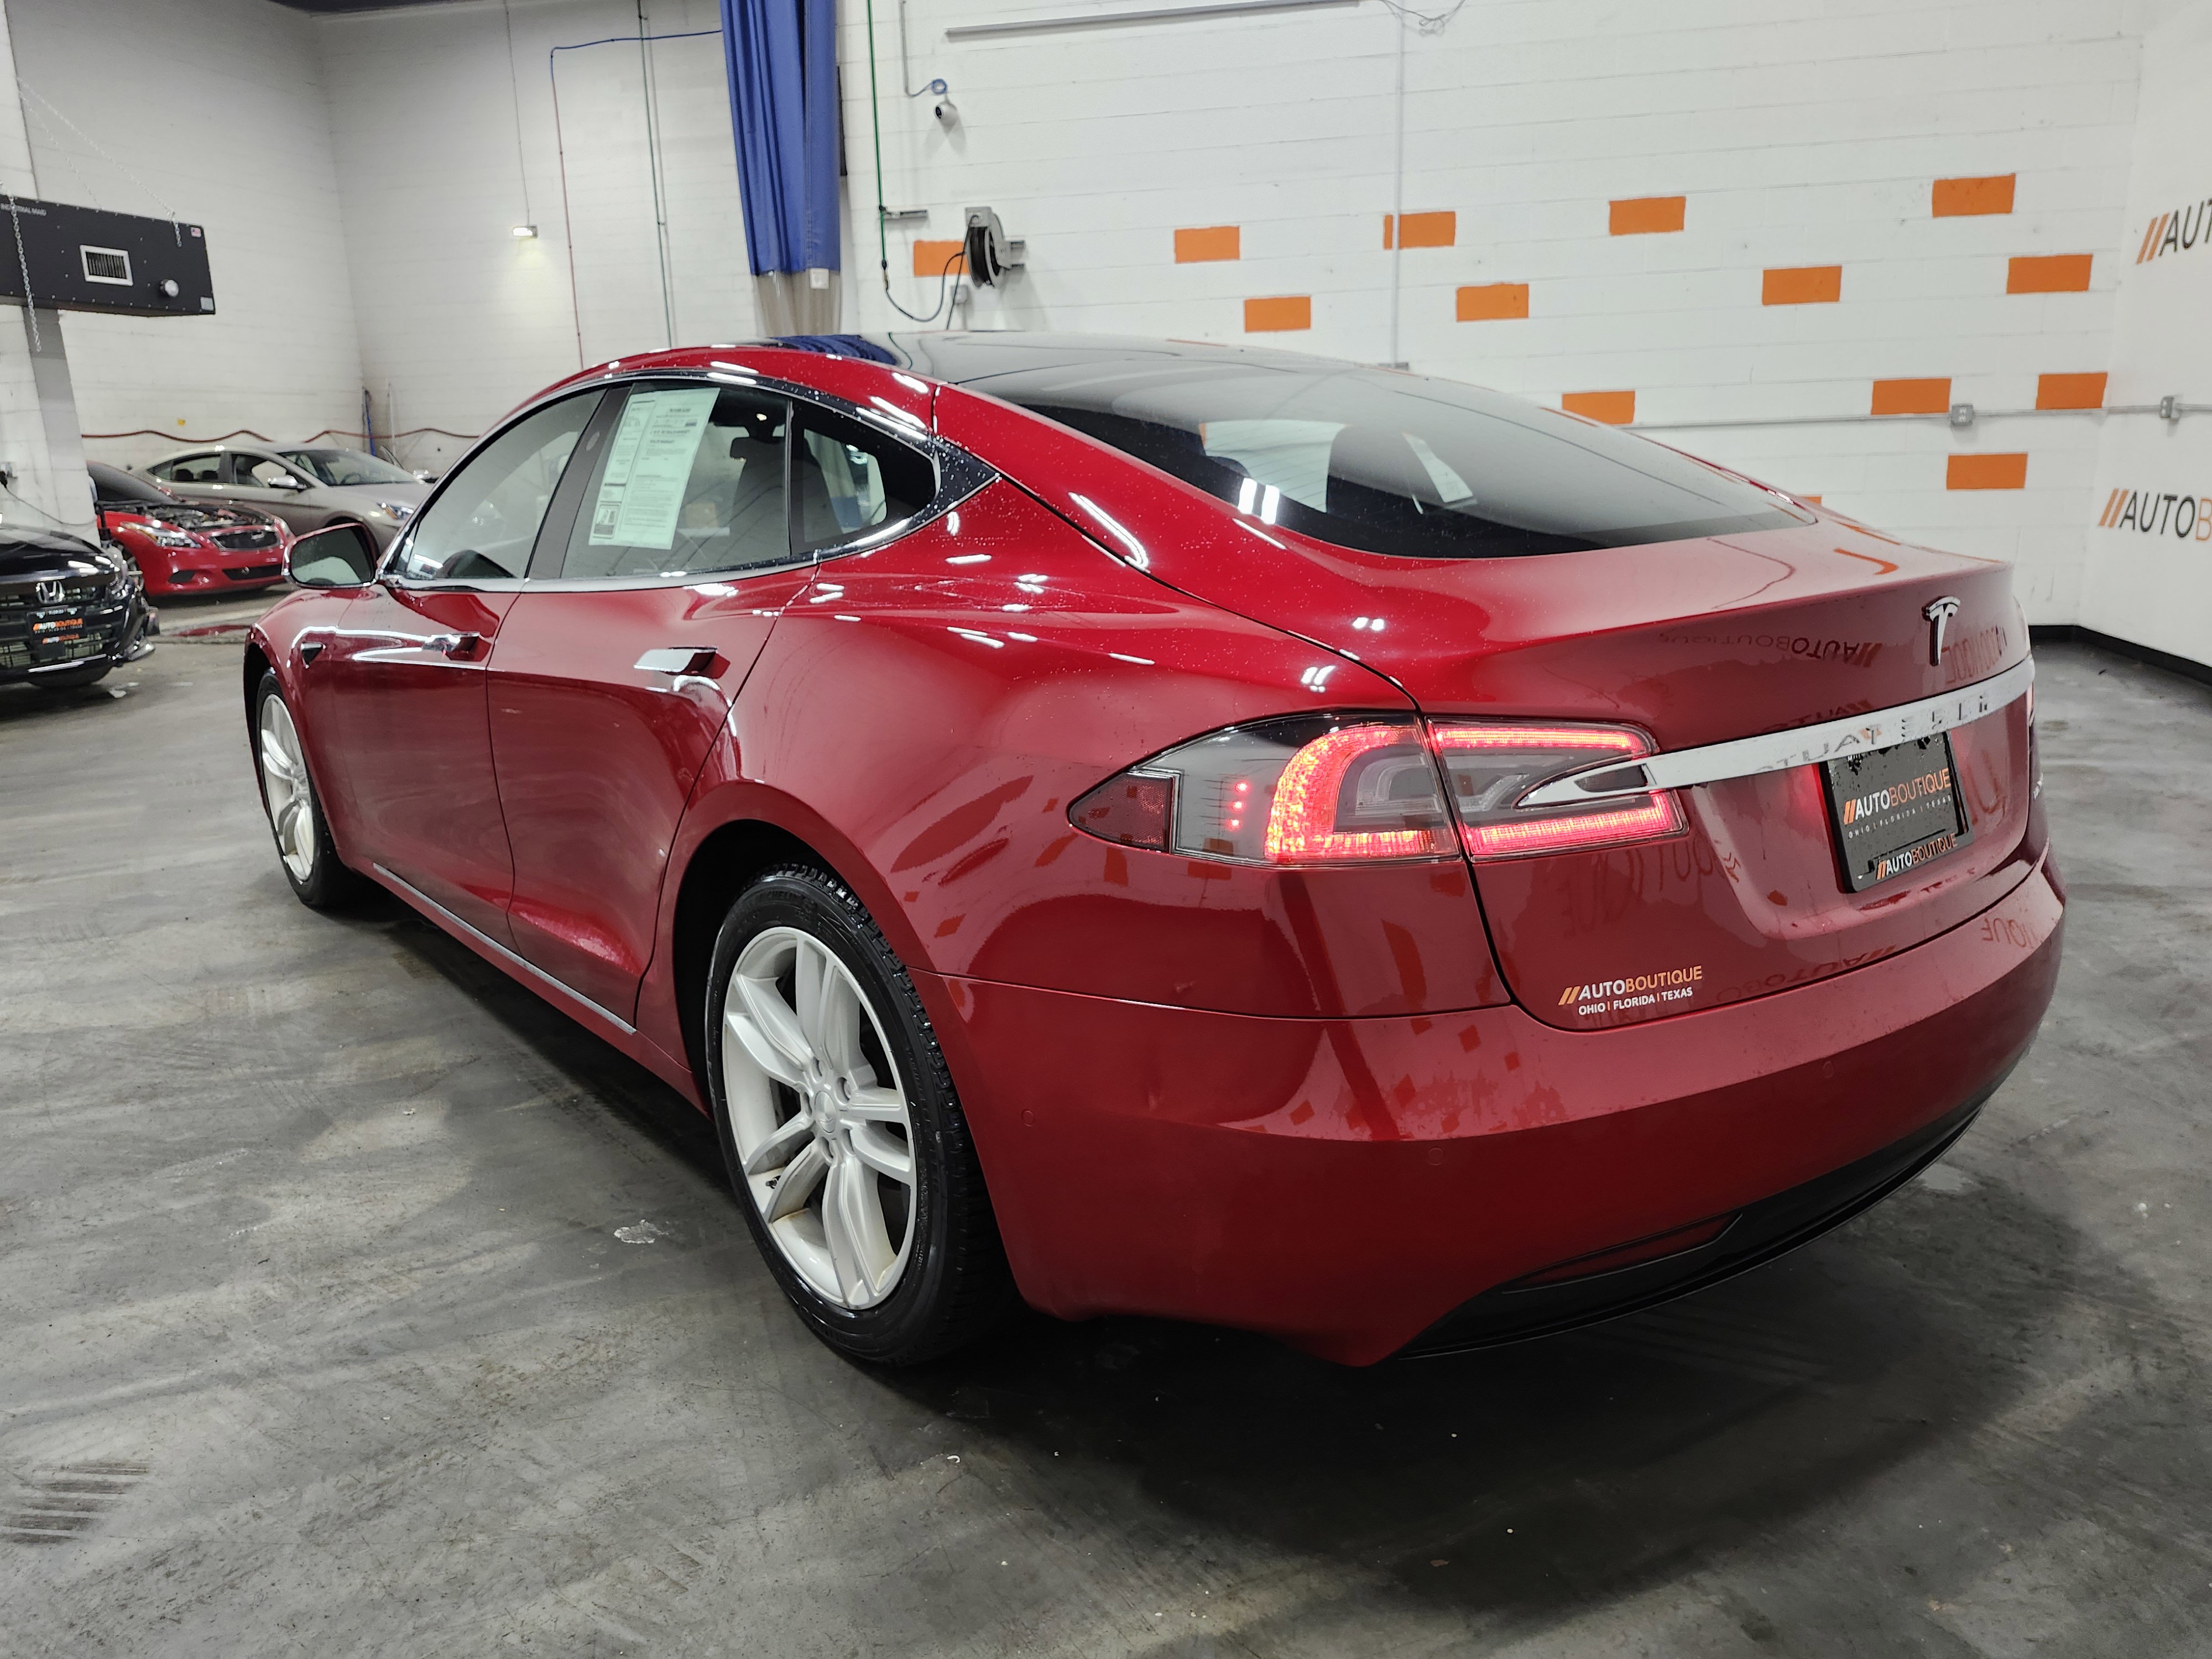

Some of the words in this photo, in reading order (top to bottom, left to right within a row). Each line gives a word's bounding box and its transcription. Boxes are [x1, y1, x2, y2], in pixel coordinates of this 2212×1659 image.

[1855, 768, 1952, 821] AUTOBOUTIQUE
[1849, 825, 1870, 839] OHIO
[1880, 807, 1916, 827] FLORIDA
[1926, 794, 1952, 810] TEXAS
[1886, 833, 1958, 876] AUTOBOUTIQUE
[1578, 966, 1703, 1001] AUTOBOUTIQUE
[1578, 1003, 1606, 1016] OHIO
[1613, 994, 1655, 1010] FLORIDA
[1661, 987, 1693, 1001] TEXAS
